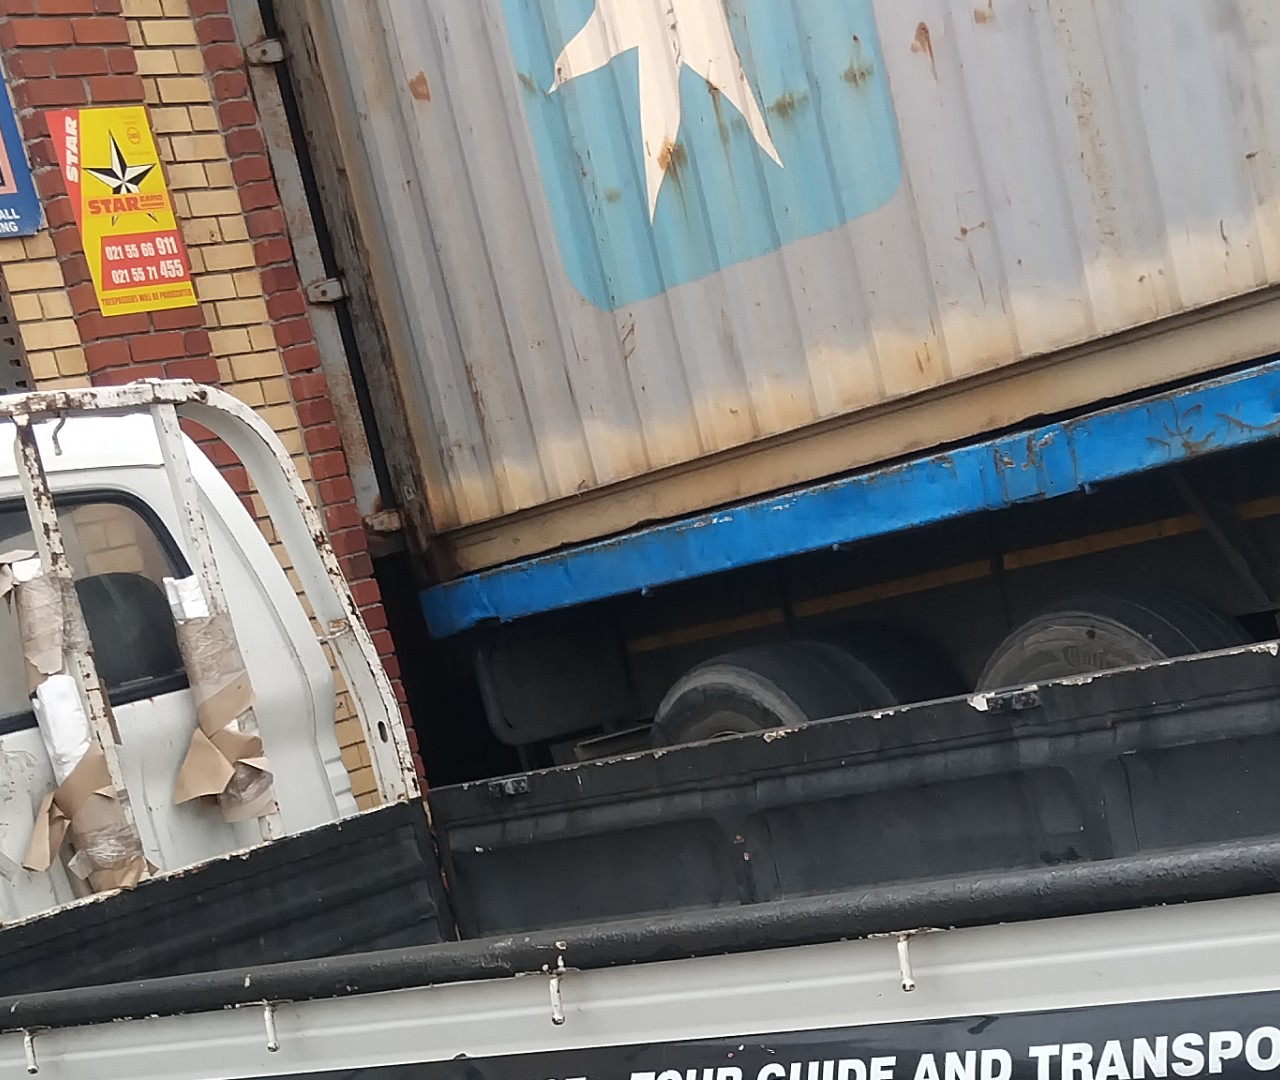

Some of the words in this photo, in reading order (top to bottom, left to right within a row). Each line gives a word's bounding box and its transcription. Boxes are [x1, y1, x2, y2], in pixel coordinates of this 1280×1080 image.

[65, 116, 79, 183] STAR
[88, 197, 140, 215] STAR
[105, 245, 124, 261] 021
[124, 244, 140, 259] 55
[140, 242, 155, 257] 66
[155, 236, 178, 255] 911
[111, 269, 131, 284] 021
[131, 267, 146, 282] 55
[146, 266, 159, 280] 71
[160, 259, 184, 278] 455
